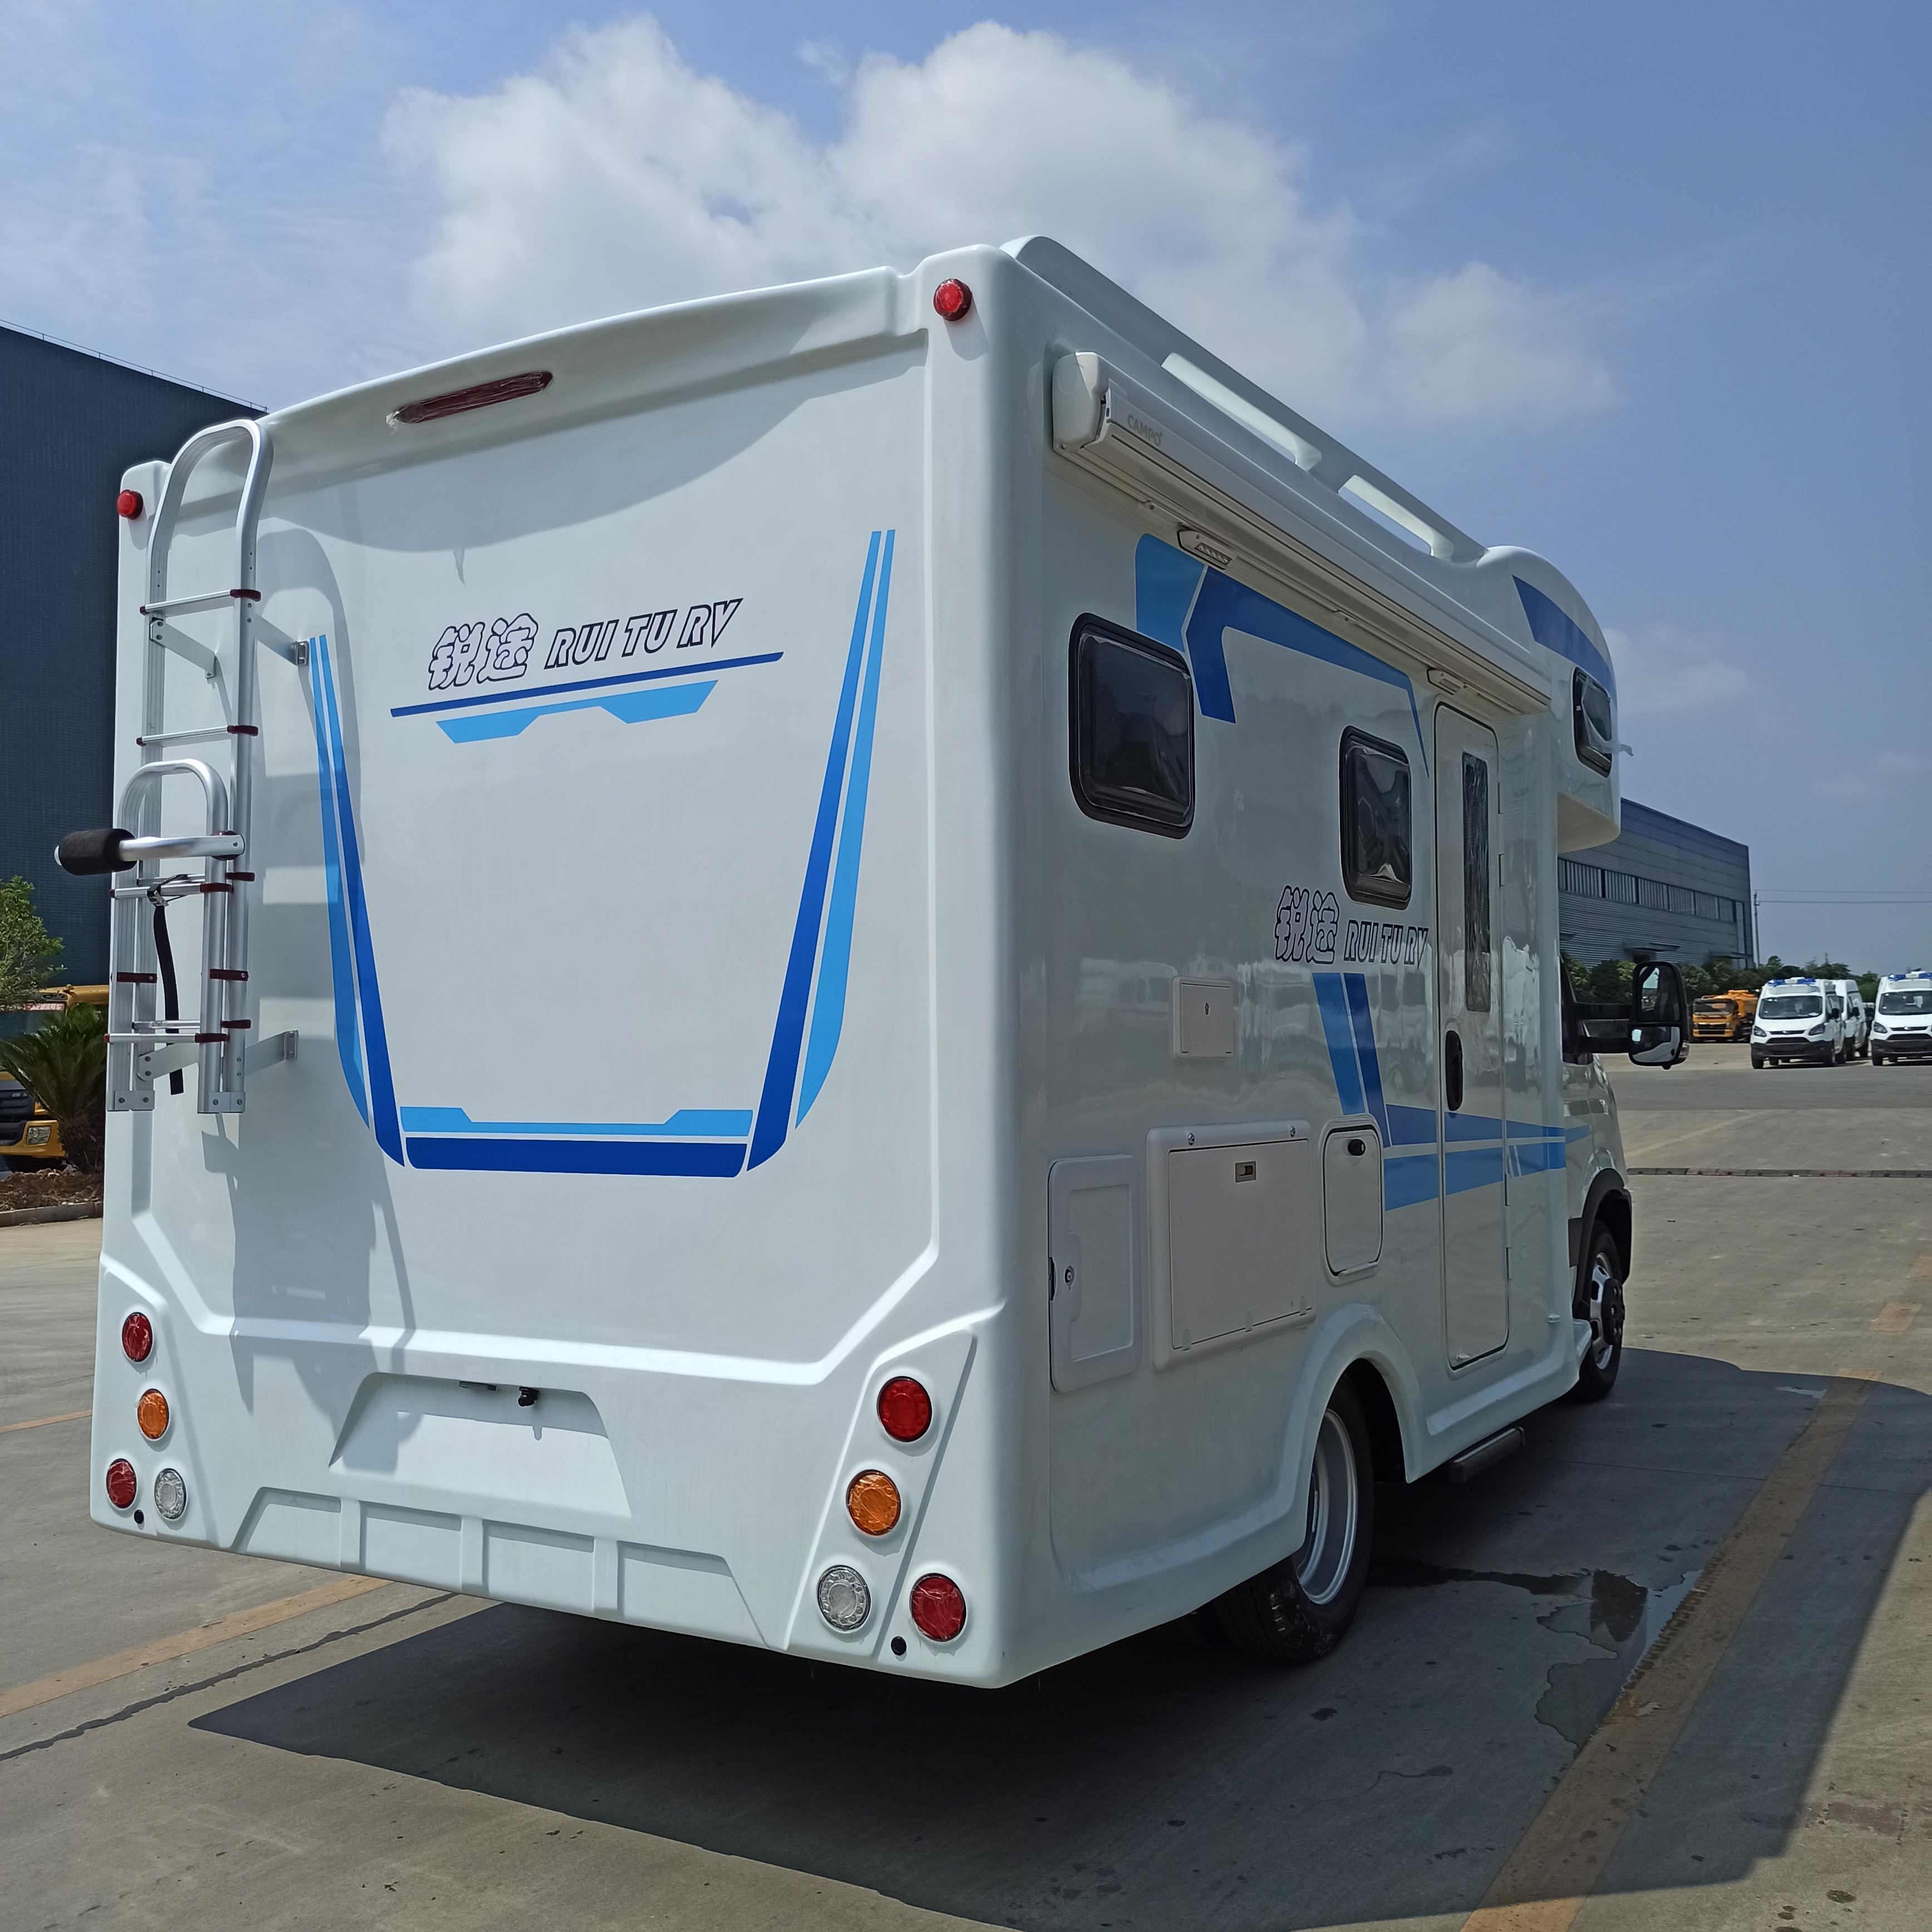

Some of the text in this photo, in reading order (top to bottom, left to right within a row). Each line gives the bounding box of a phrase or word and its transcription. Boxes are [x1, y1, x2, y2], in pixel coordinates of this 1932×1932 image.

[428, 598, 743, 691] 锐途 RUI TU RV
[1275, 885, 1429, 970] 锐途 RUI TU RV
